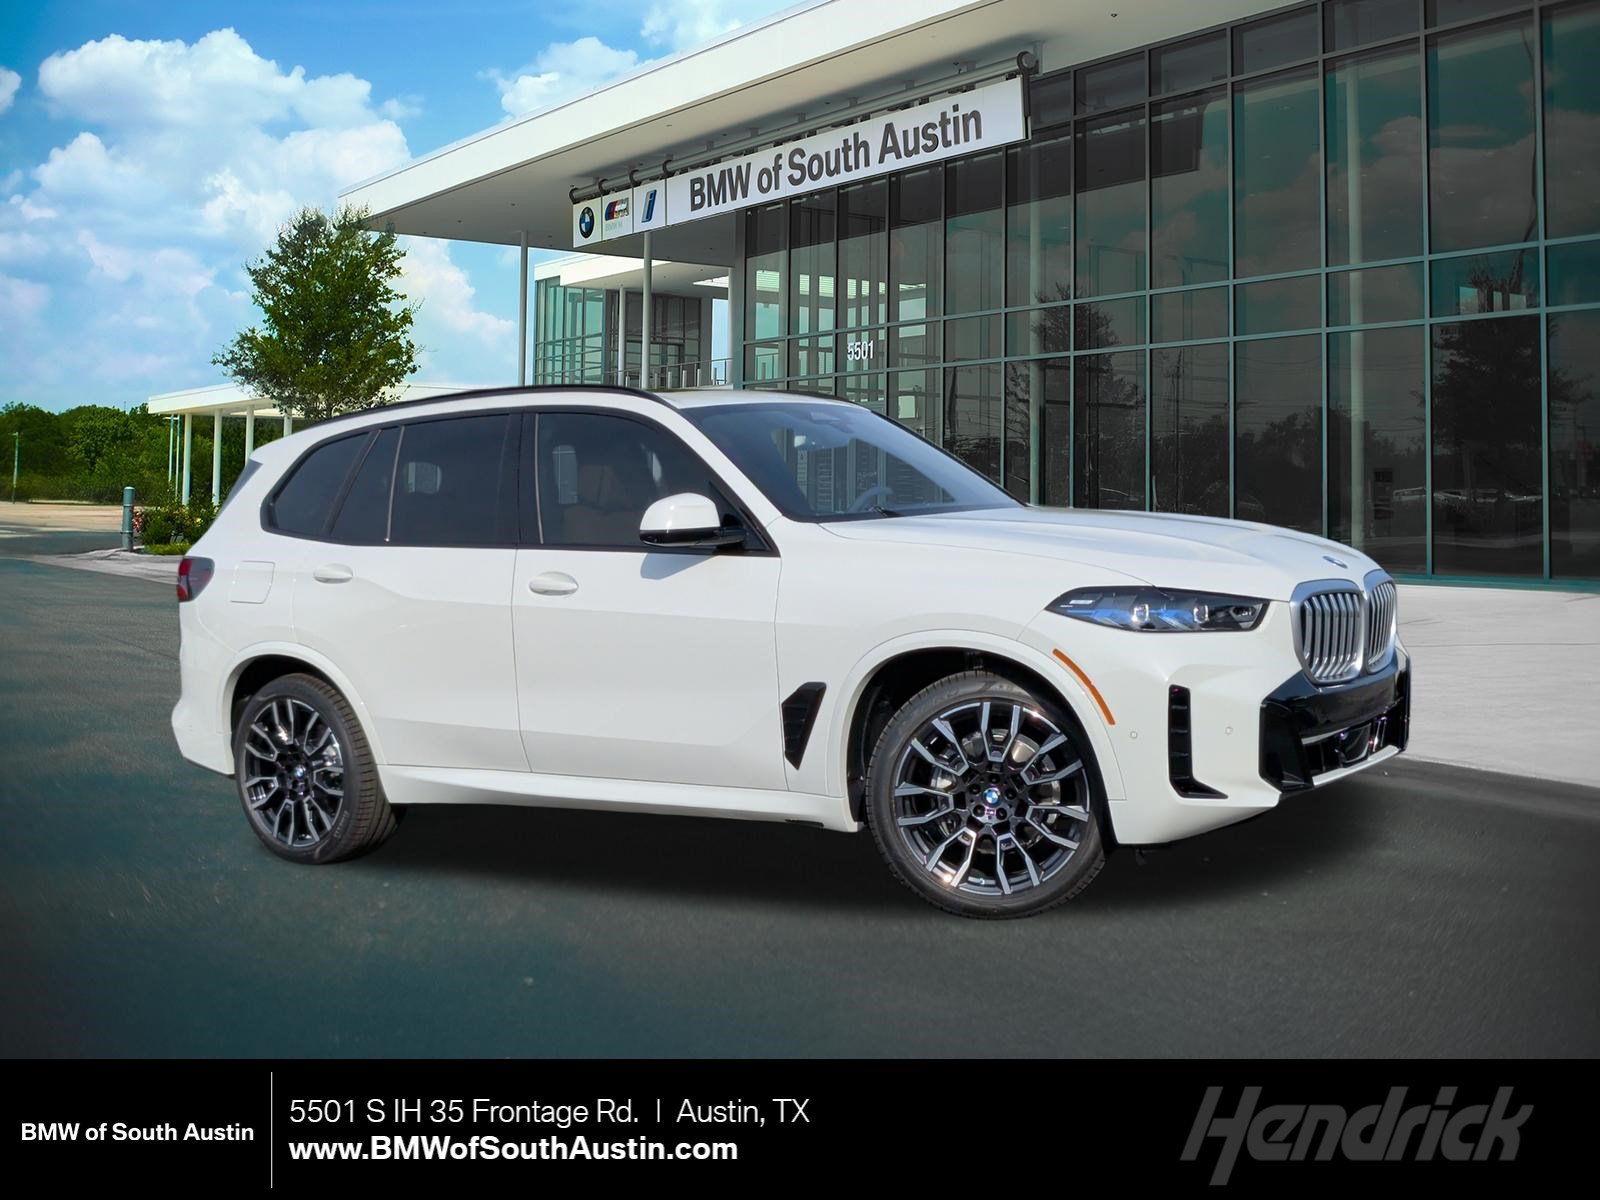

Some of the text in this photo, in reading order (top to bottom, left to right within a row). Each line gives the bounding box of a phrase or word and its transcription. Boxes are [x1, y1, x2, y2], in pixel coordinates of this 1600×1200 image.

[689, 161, 752, 213] BMW
[757, 152, 784, 195] of
[787, 131, 872, 188] South
[877, 102, 983, 165] Austin
[847, 340, 874, 361] 5501
